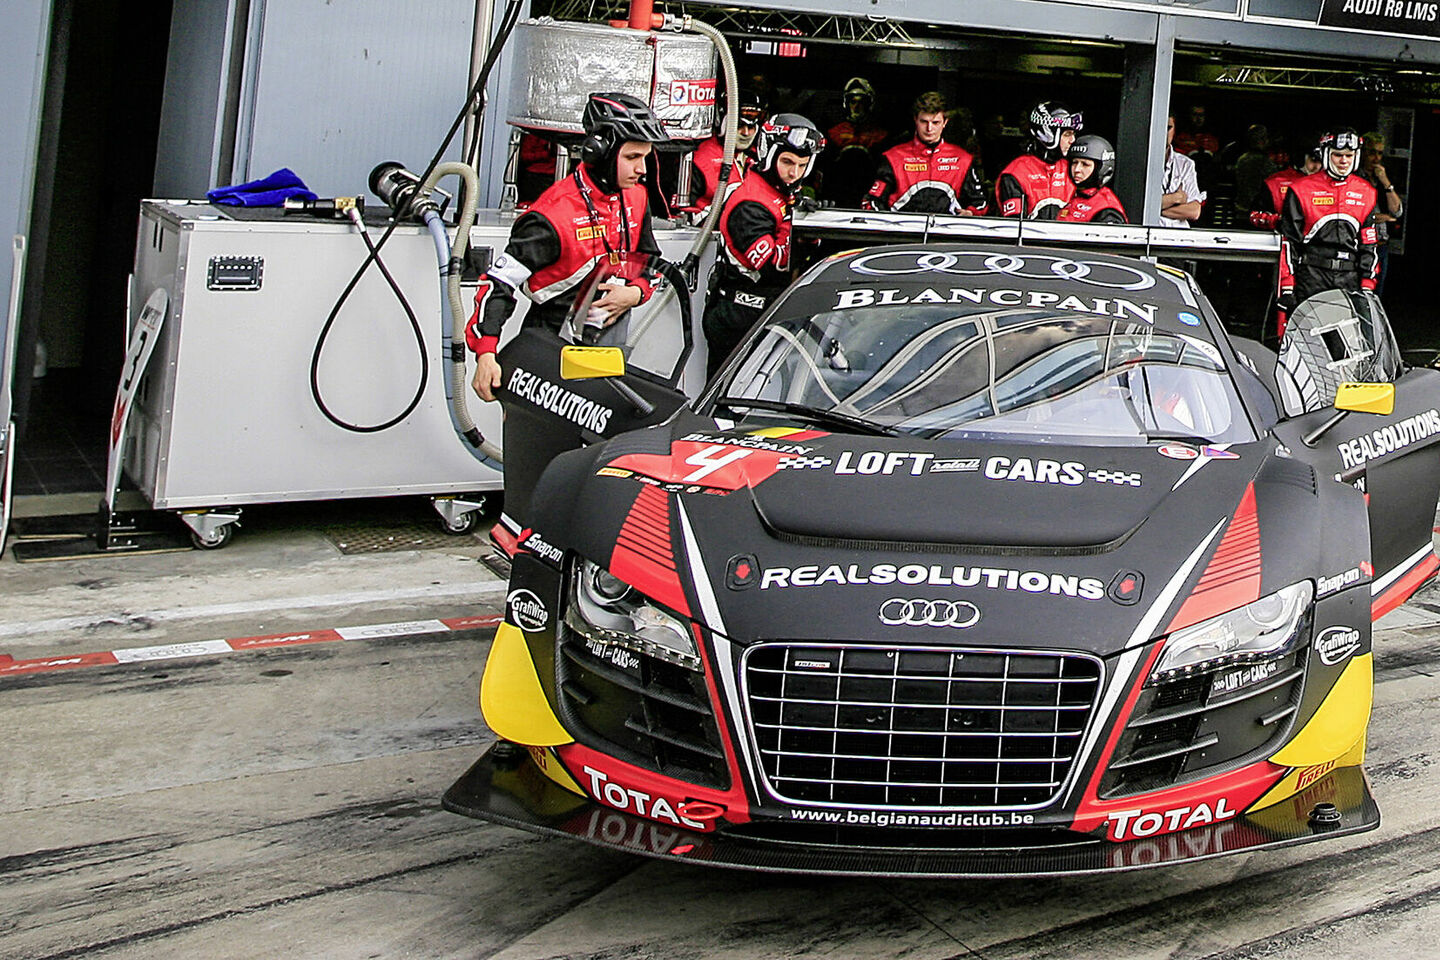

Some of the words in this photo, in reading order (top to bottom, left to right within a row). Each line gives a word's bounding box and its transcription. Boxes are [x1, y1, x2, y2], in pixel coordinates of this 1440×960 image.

[1403, 0, 1438, 23] LMS
[688, 84, 716, 101] TOTA
[832, 287, 1160, 325] BLANCPAIN
[507, 367, 613, 435] REALSOLUTIONS
[680, 433, 814, 456] BLANCPAIN
[682, 444, 754, 483] 4
[833, 451, 936, 477] LOFT
[983, 455, 1086, 487] CARS
[523, 532, 564, 563] Snap-on
[759, 563, 1106, 601] REALSOLUTIONS
[1315, 567, 1360, 597] Snap-on
[511, 596, 549, 623] GrafiWrap
[1317, 629, 1361, 655] GrafiWrap
[611, 648, 631, 669] CARS
[1224, 670, 1243, 691] LOFT
[1250, 664, 1269, 683] CARS
[1294, 759, 1338, 792] PIRELLI
[583, 765, 706, 829] TOTAL
[789, 806, 1036, 828] www.belgianaudiclub.be
[1106, 798, 1237, 840] TOTAL
